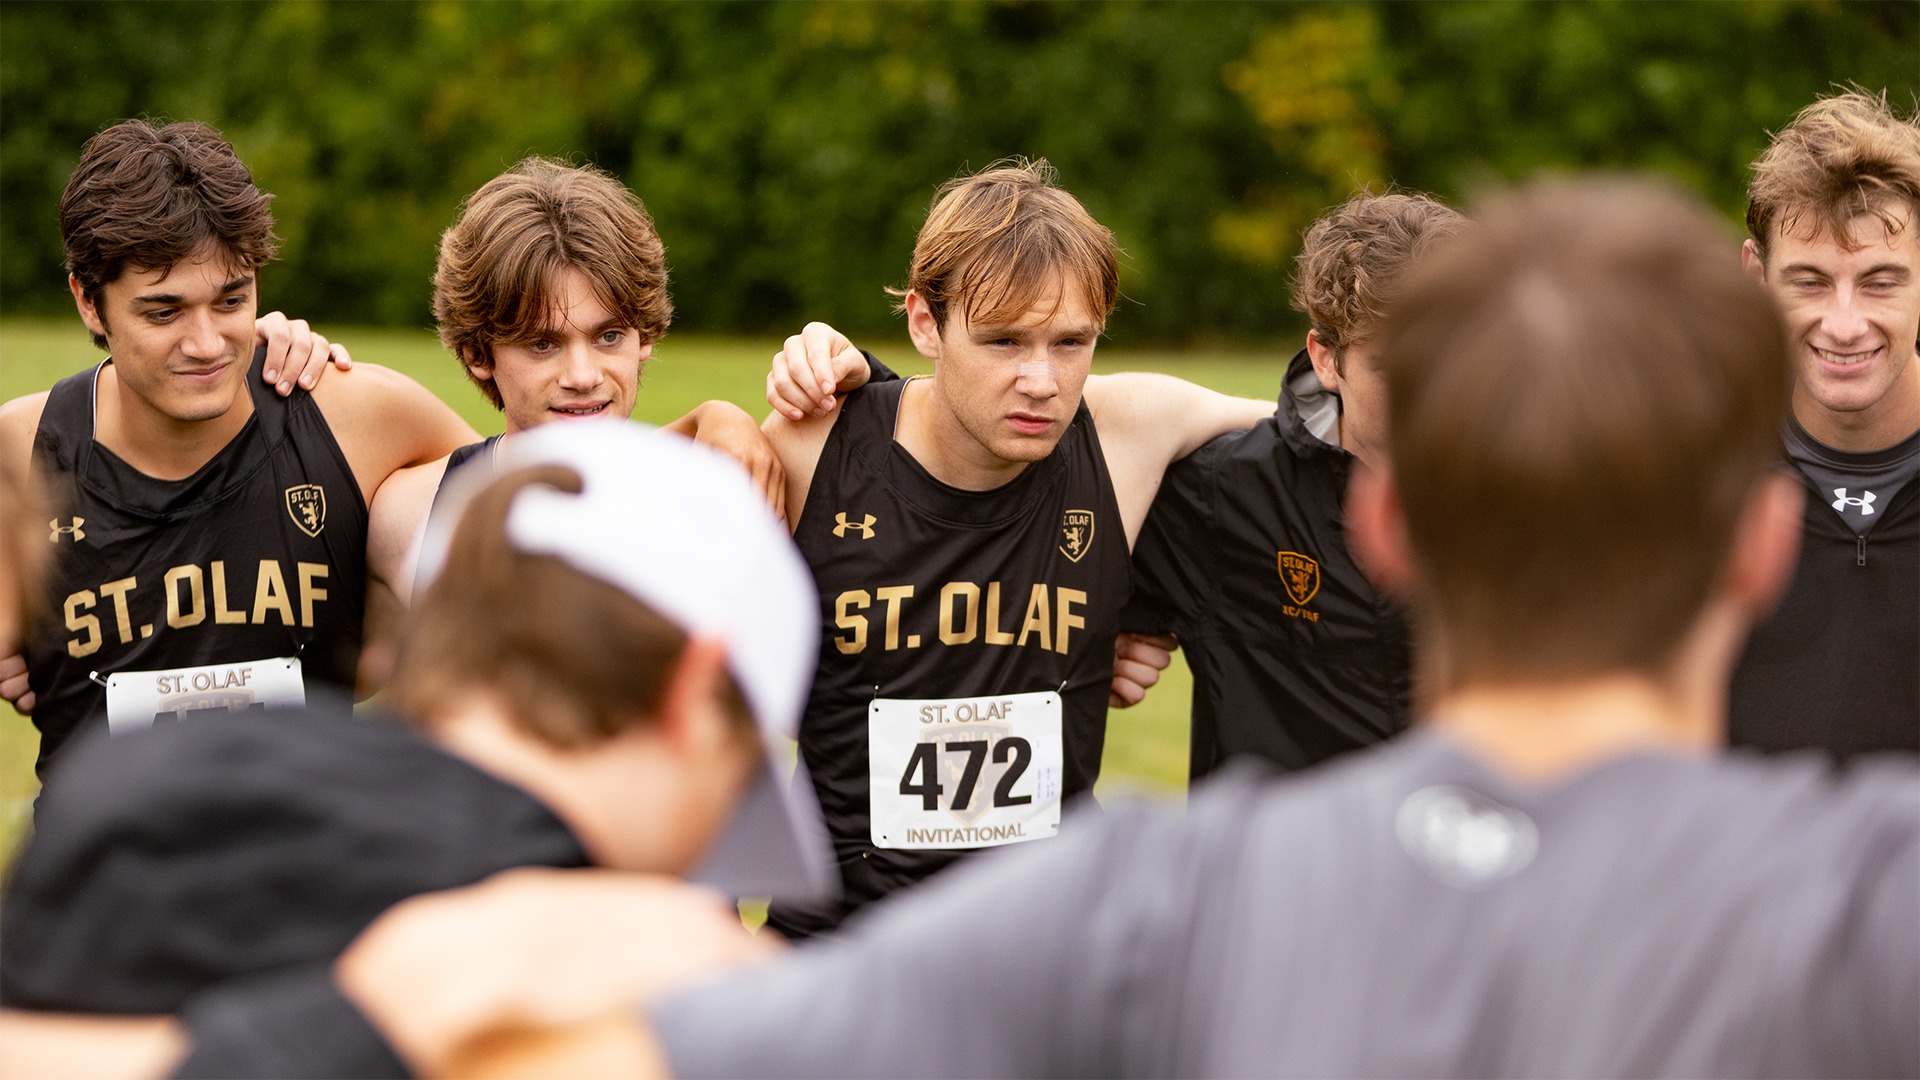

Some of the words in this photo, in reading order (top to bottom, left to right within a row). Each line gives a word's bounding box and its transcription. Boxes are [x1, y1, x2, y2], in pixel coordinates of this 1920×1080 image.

[1069, 515, 1089, 526] OLAF
[63, 576, 154, 659] ST.
[163, 559, 329, 630] OLAF
[834, 585, 921, 655] ST.
[939, 581, 1087, 655] OLAF
[157, 674, 188, 694] ST.
[192, 668, 252, 692] OLAF
[919, 704, 950, 724] ST.
[954, 701, 1013, 722] OLAF
[899, 736, 1032, 811] 472
[906, 823, 1026, 843] INVITATIONAL
